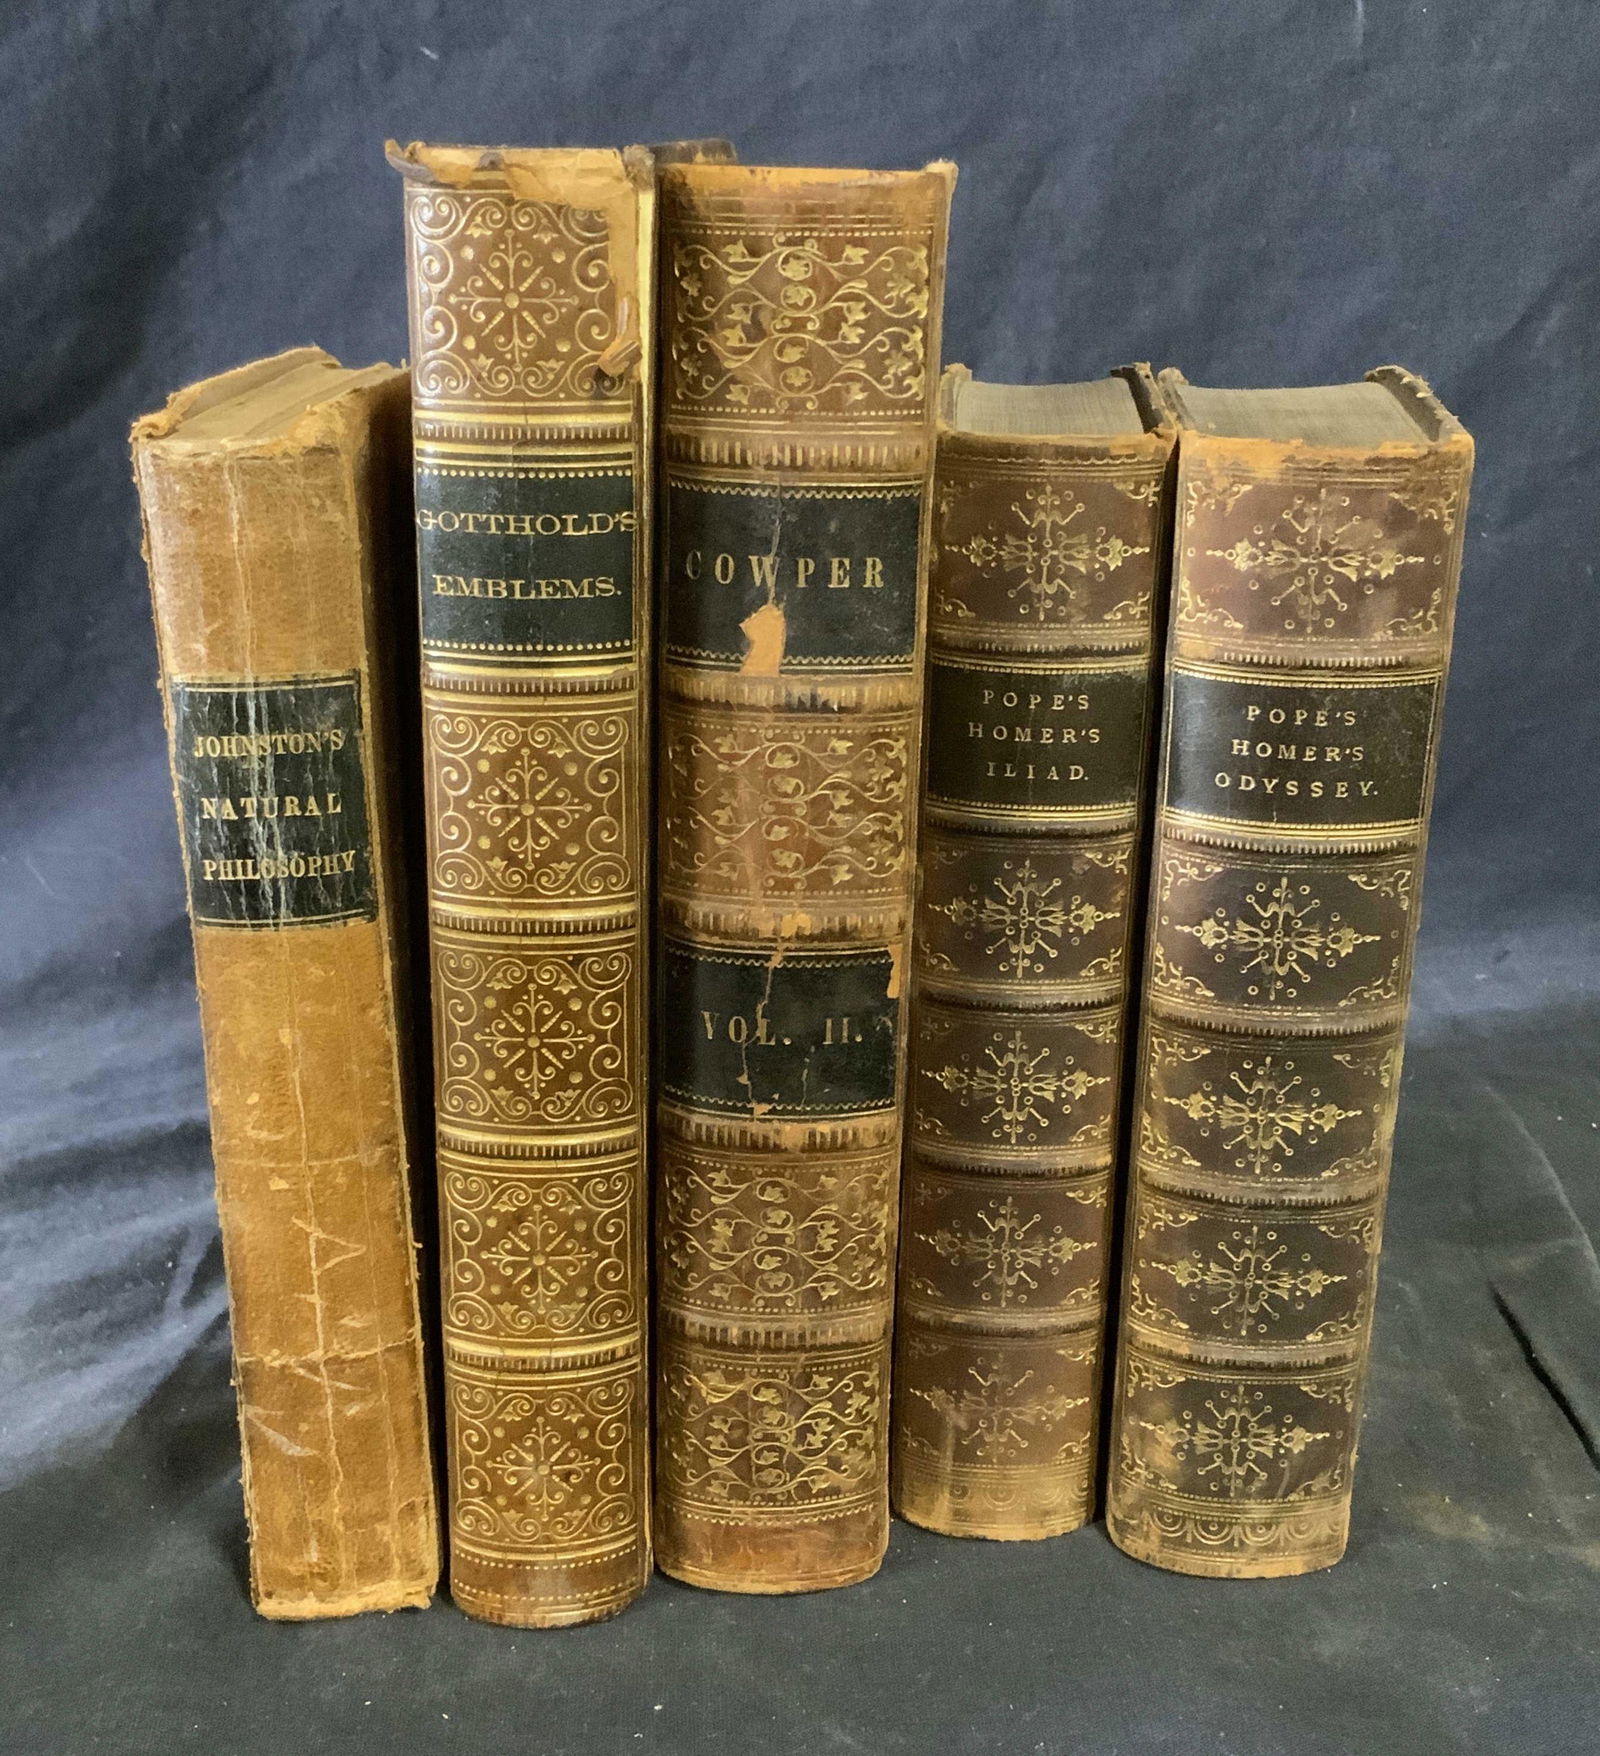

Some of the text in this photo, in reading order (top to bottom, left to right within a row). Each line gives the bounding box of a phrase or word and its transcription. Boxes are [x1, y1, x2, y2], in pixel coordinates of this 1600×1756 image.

[416, 509, 638, 536] GOTTHOLD'S
[686, 551, 884, 588] COWPER
[432, 574, 622, 600] EMBLEMS.
[983, 690, 1089, 710] POPE'S
[1247, 705, 1356, 727] POPE'S
[194, 729, 344, 758] JOHNSTON'S
[968, 722, 1101, 744] HOMER'S
[1231, 739, 1364, 762] HOMER'S
[986, 762, 1089, 780] ILIAD.
[1214, 772, 1378, 798] ODYSSEY.
[201, 793, 342, 820] NATURAL
[203, 850, 356, 881] PHILOSOPHY
[701, 1011, 863, 1046] VOL. II.
